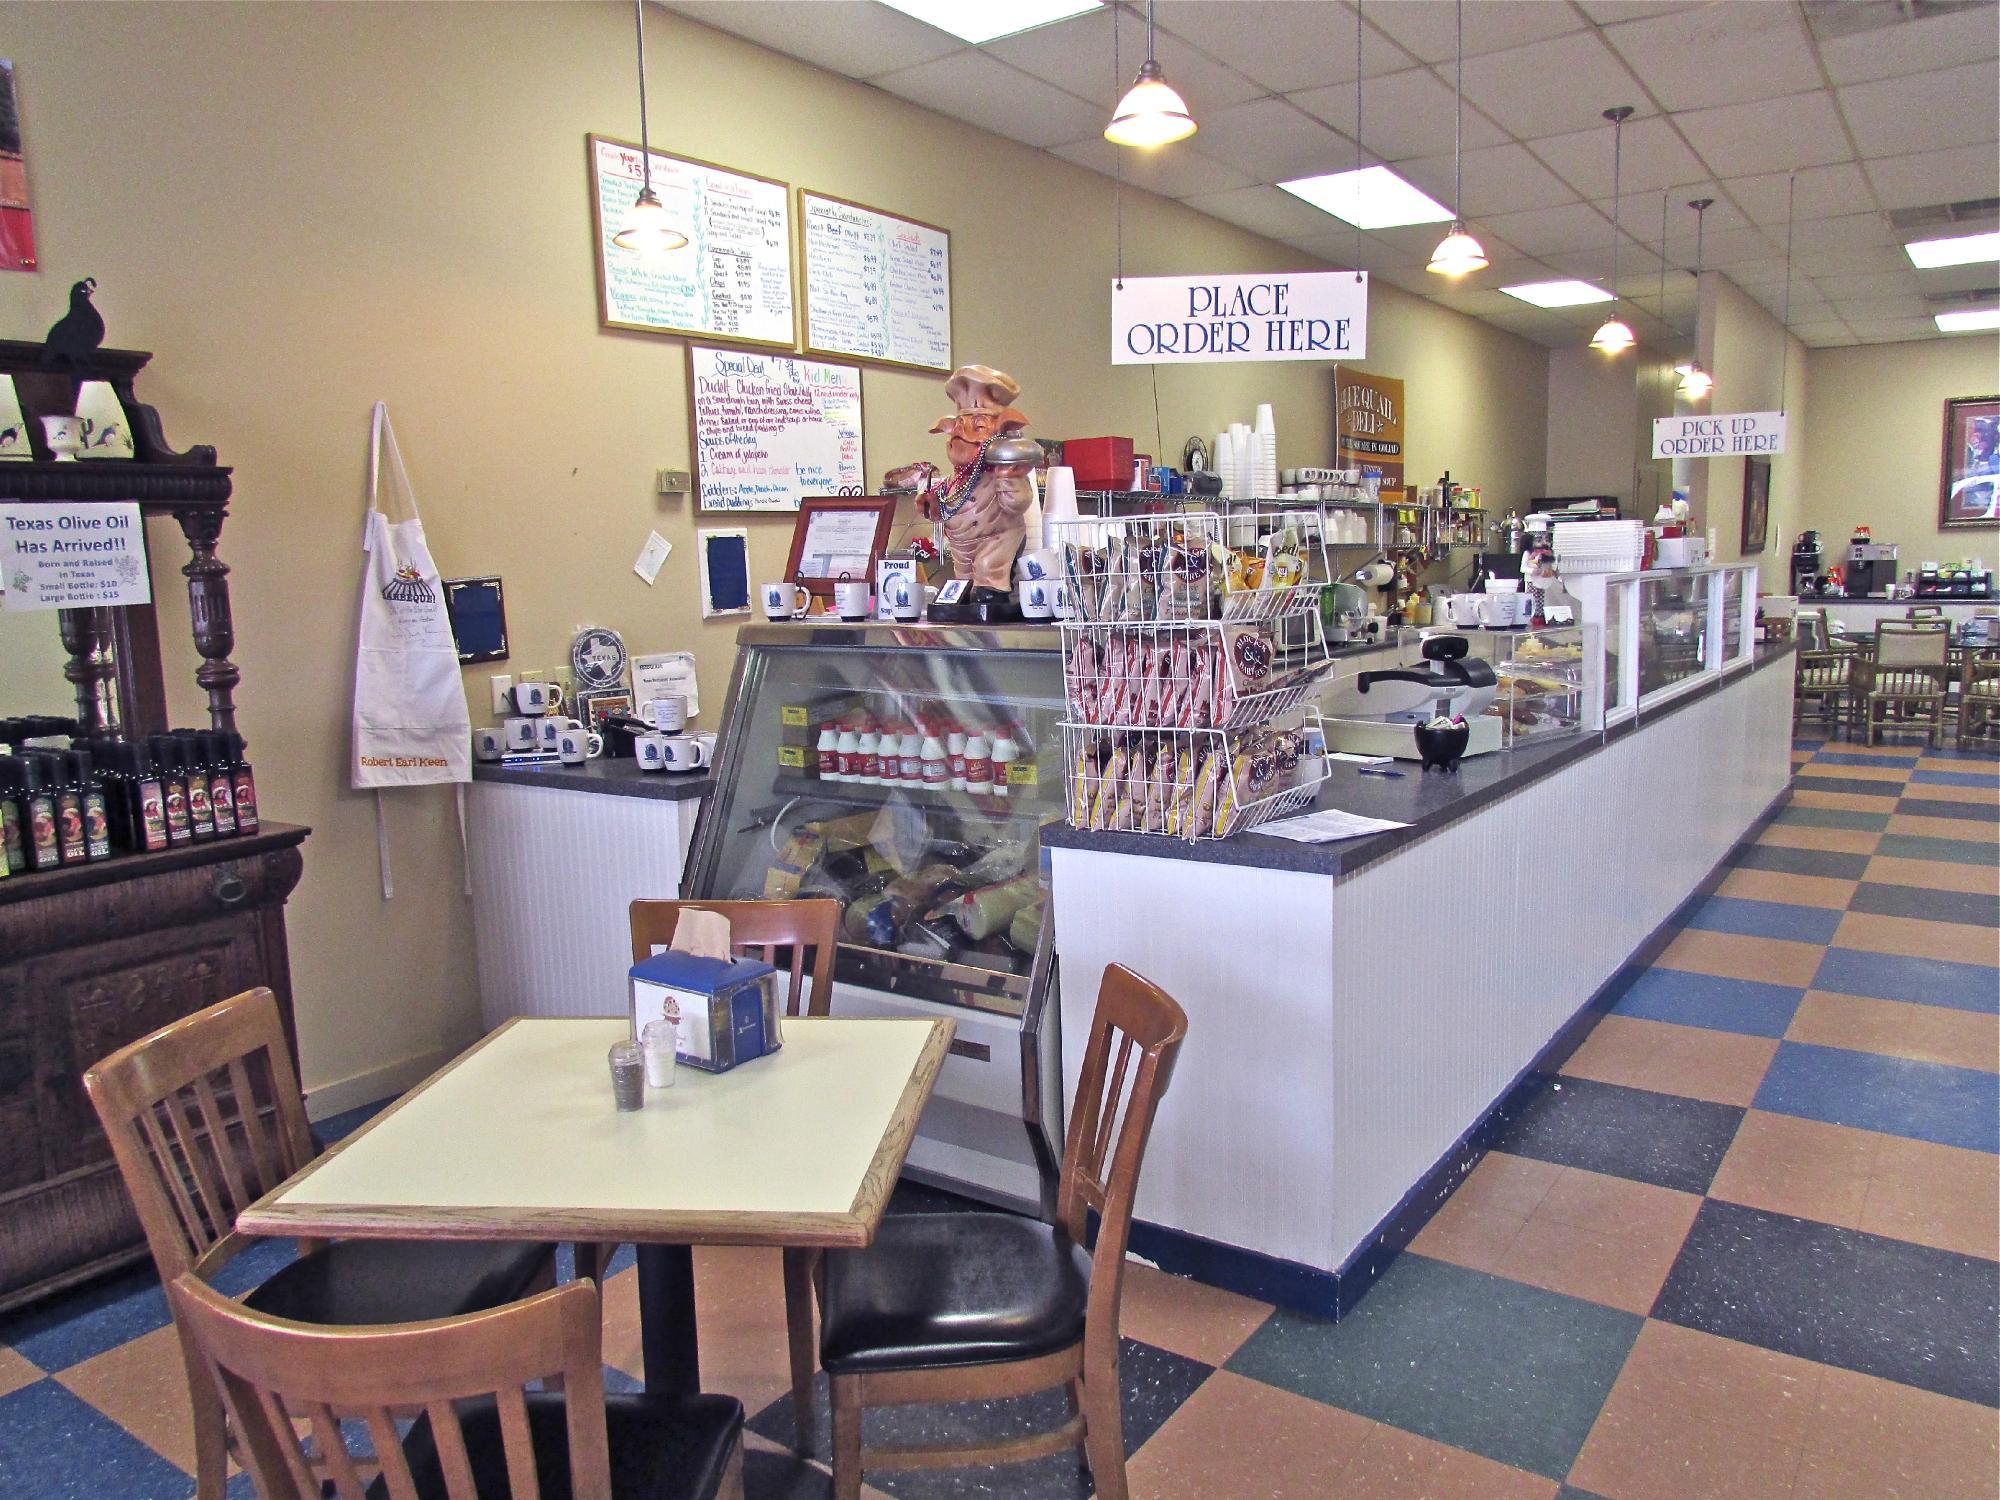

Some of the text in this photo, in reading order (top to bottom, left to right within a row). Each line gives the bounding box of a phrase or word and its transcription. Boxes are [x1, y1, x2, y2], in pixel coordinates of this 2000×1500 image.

[620, 153, 635, 165] Your
[827, 224, 842, 235] Beef
[1188, 283, 1289, 317] PLACE
[1127, 317, 1350, 355] ORDER HERE
[715, 351, 764, 377] Special Deal
[804, 365, 820, 383] Kid
[737, 379, 764, 396] Chicken
[1361, 387, 1397, 425] QUAIL
[1352, 411, 1375, 435] DELI
[1682, 418, 1756, 436] PICK UP
[1371, 442, 1378, 452] IN
[1661, 434, 1778, 455] ORDER HERE
[710, 448, 733, 460] Cream
[796, 462, 823, 475] be nice
[807, 477, 832, 488] everyone
[1382, 477, 1397, 486] SOUP
[6, 516, 129, 530] Texas Olive Oil
[16, 538, 125, 553] Has Arrived!!
[68, 582, 98, 590] Bottle:
[100, 580, 117, 588] $10
[361, 757, 448, 766] Robert Earl Keen
